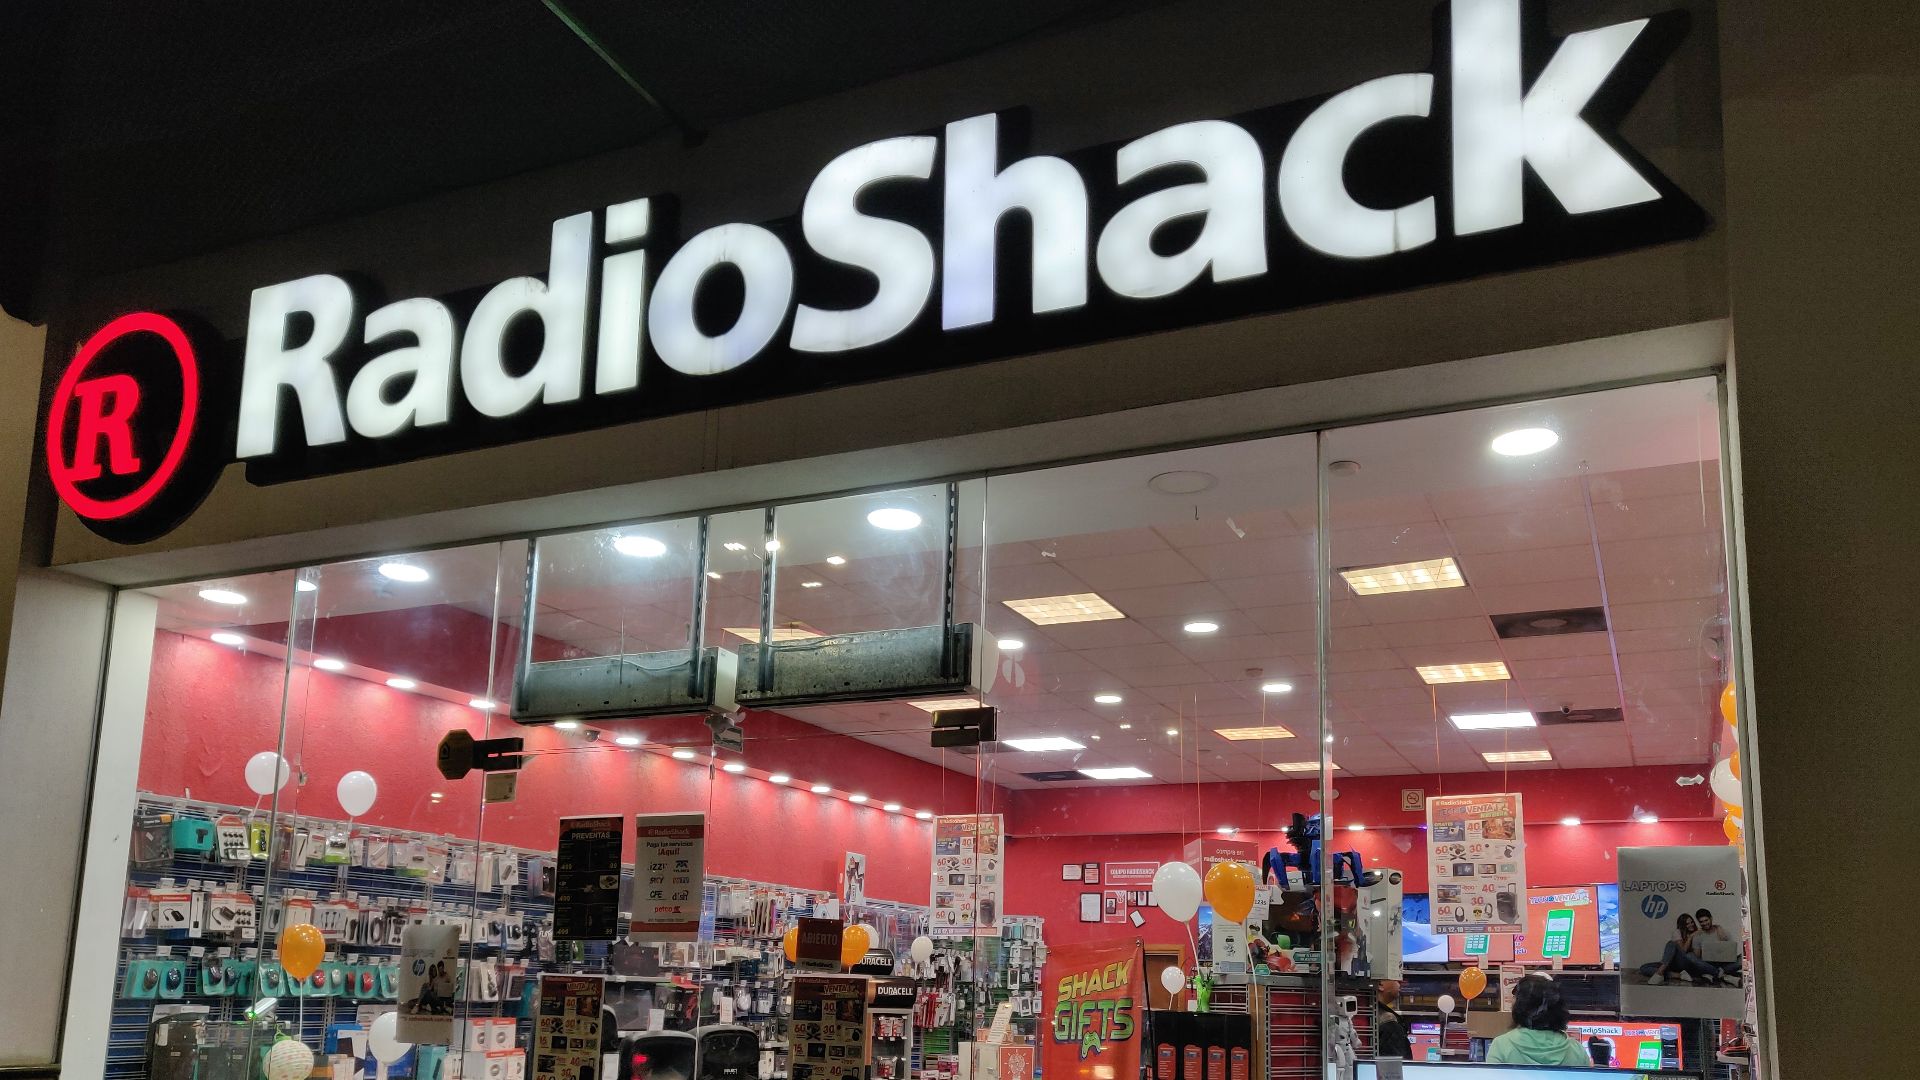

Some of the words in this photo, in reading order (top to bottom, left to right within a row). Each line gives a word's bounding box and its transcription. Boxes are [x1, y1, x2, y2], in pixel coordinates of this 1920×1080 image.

[236, 0, 1662, 459] RadioShack
[571, 831, 611, 840] PREVENTAS
[1622, 880, 1687, 892] LAPTOPS
[800, 932, 838, 946] ABIERTO
[1058, 959, 1134, 1002] SHACK
[877, 986, 914, 996] DURACELL
[1055, 998, 1134, 1041] GIFTS
